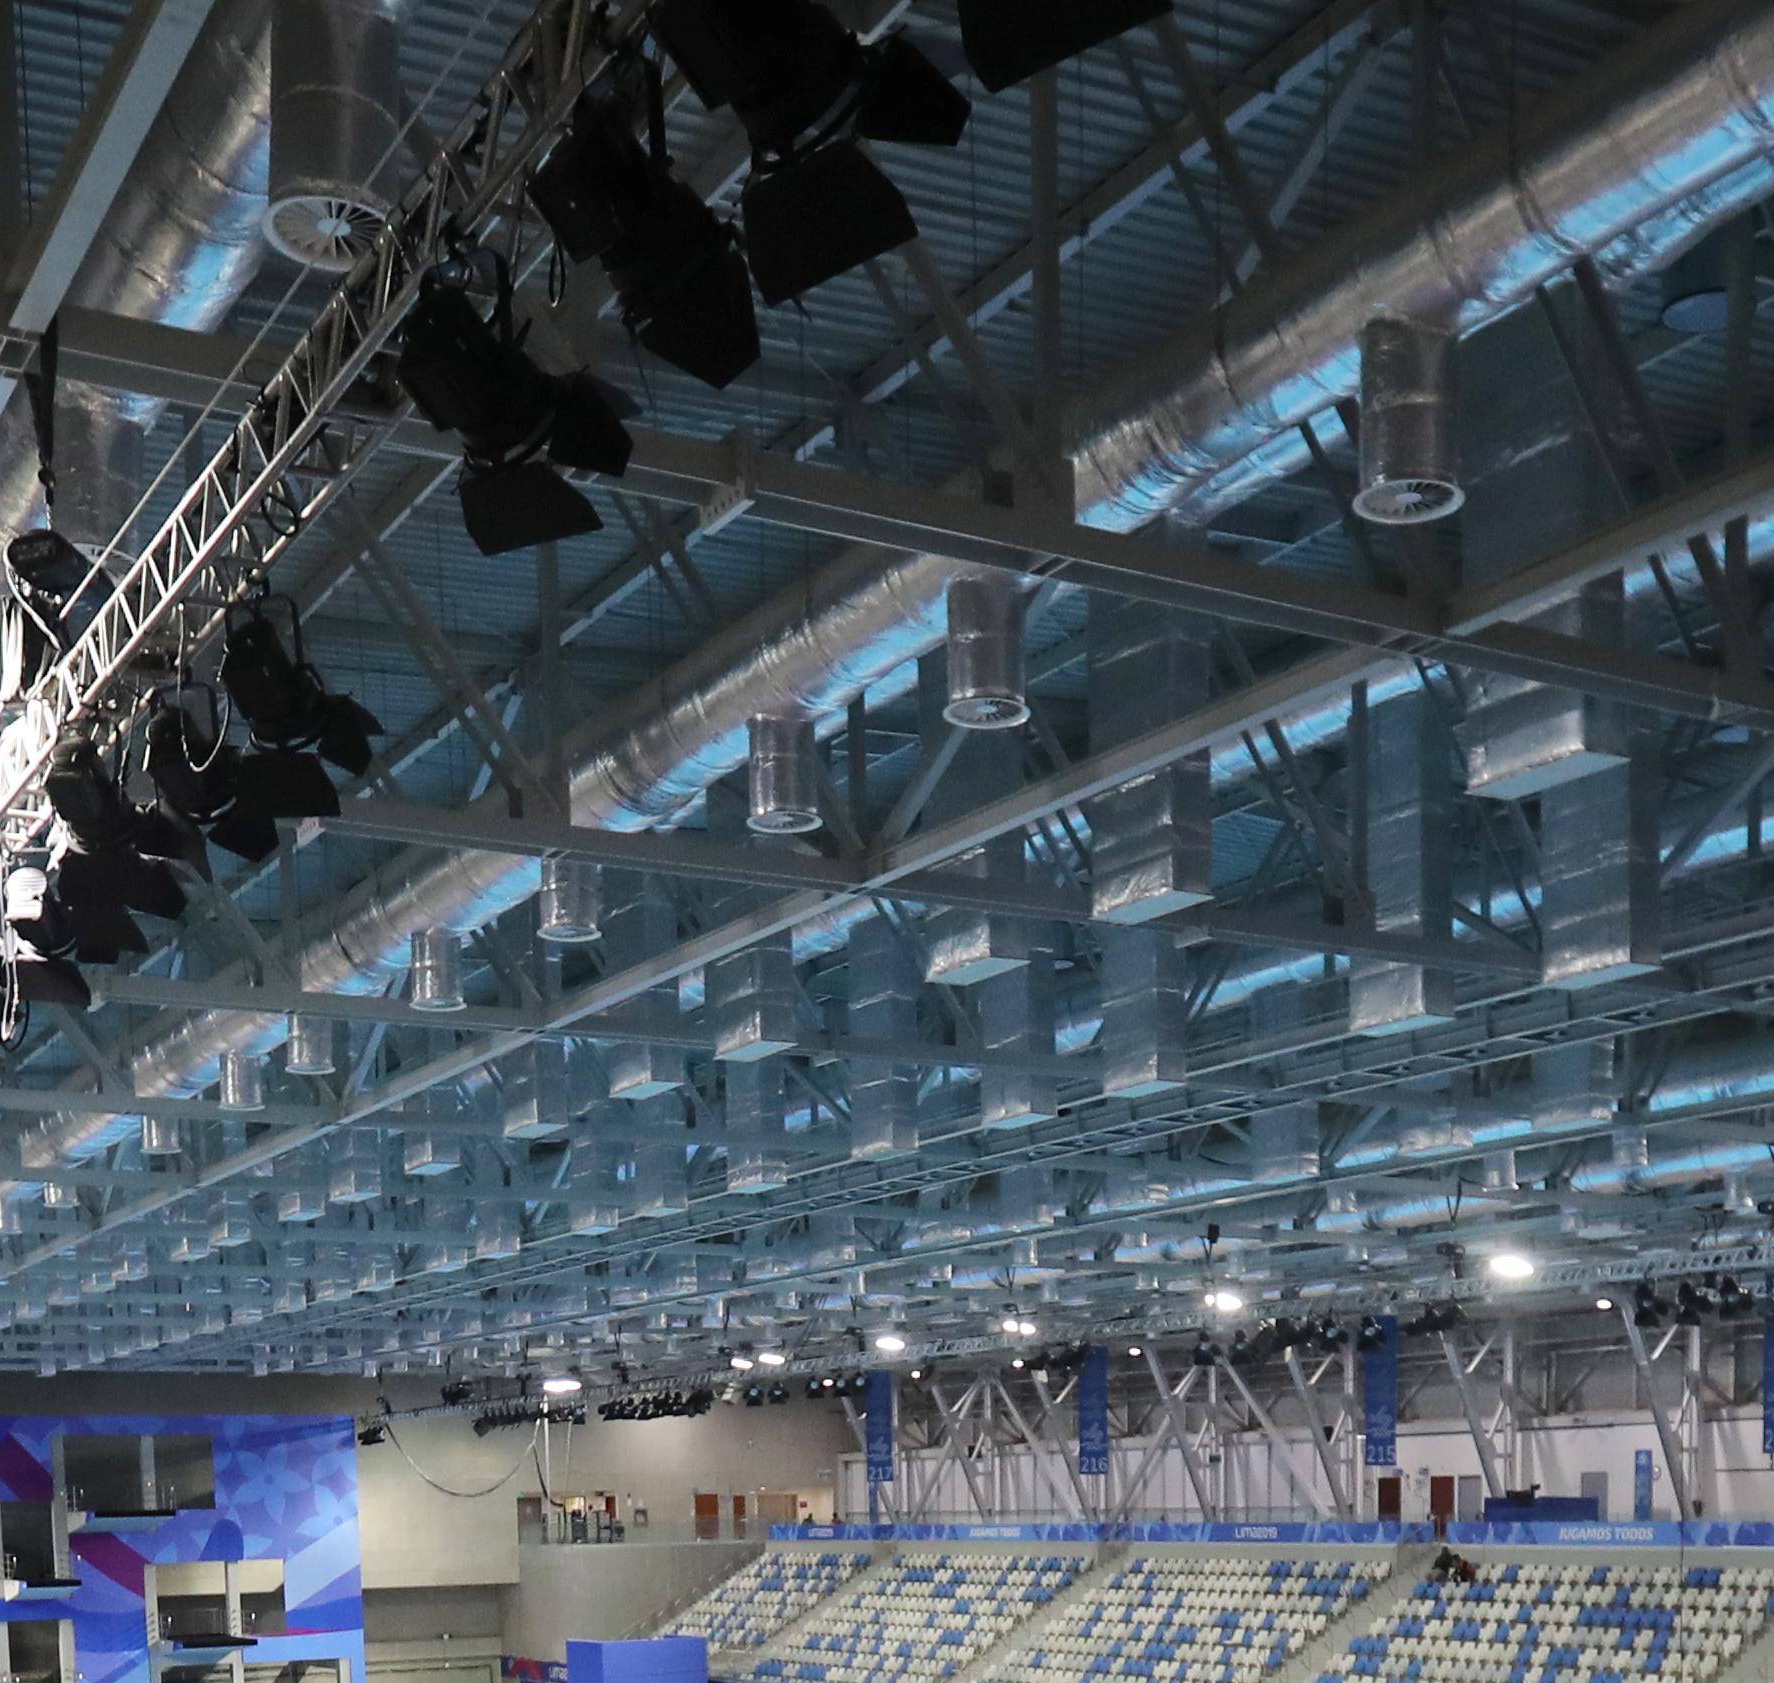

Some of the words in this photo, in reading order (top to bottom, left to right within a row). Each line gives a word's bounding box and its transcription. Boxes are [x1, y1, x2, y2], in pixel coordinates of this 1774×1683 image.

[1367, 1445, 1396, 1463] 215
[1081, 1456, 1109, 1472] 216
[868, 1466, 893, 1481] 217
